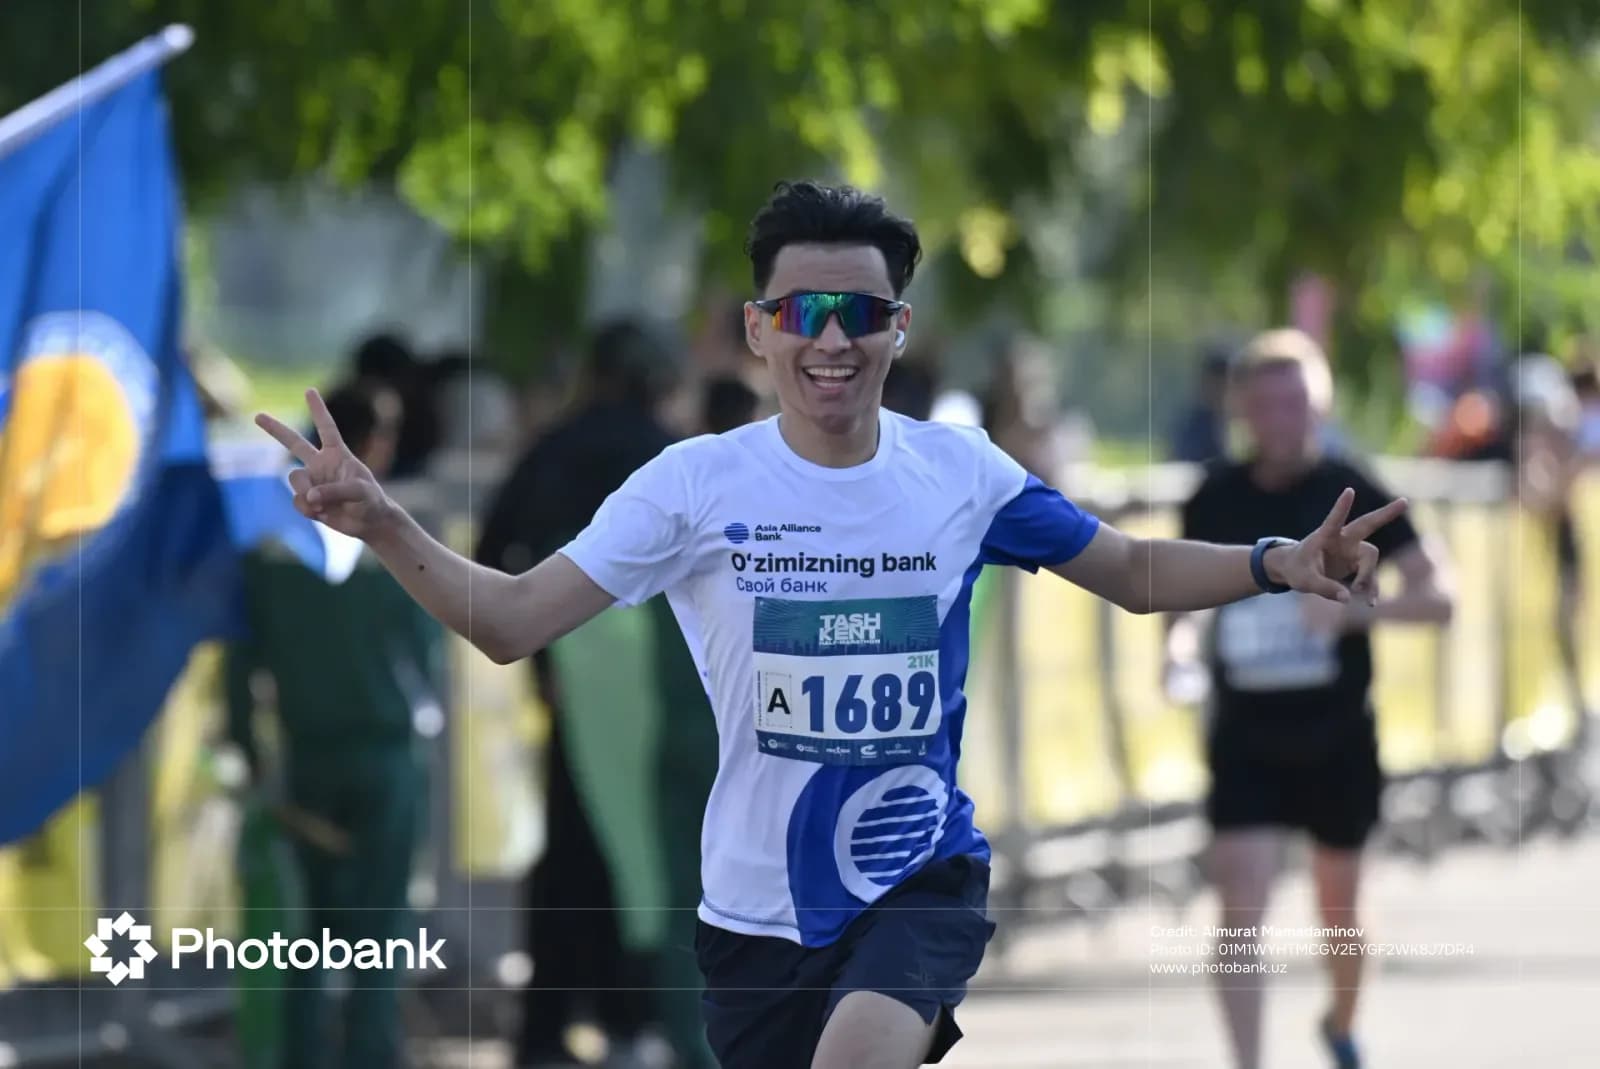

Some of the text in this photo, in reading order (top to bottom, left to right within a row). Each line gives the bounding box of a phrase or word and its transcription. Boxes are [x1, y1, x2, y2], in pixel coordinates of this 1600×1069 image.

[755, 523, 822, 533] Asia Alliance
[755, 532, 782, 541] Bank
[882, 552, 937, 572] bank
[736, 576, 828, 593] Свой банк
[819, 613, 881, 630] TASH
[819, 627, 881, 641] KENT
[907, 654, 935, 669] 21K
[767, 687, 791, 715] A
[801, 670, 936, 735] 1689
